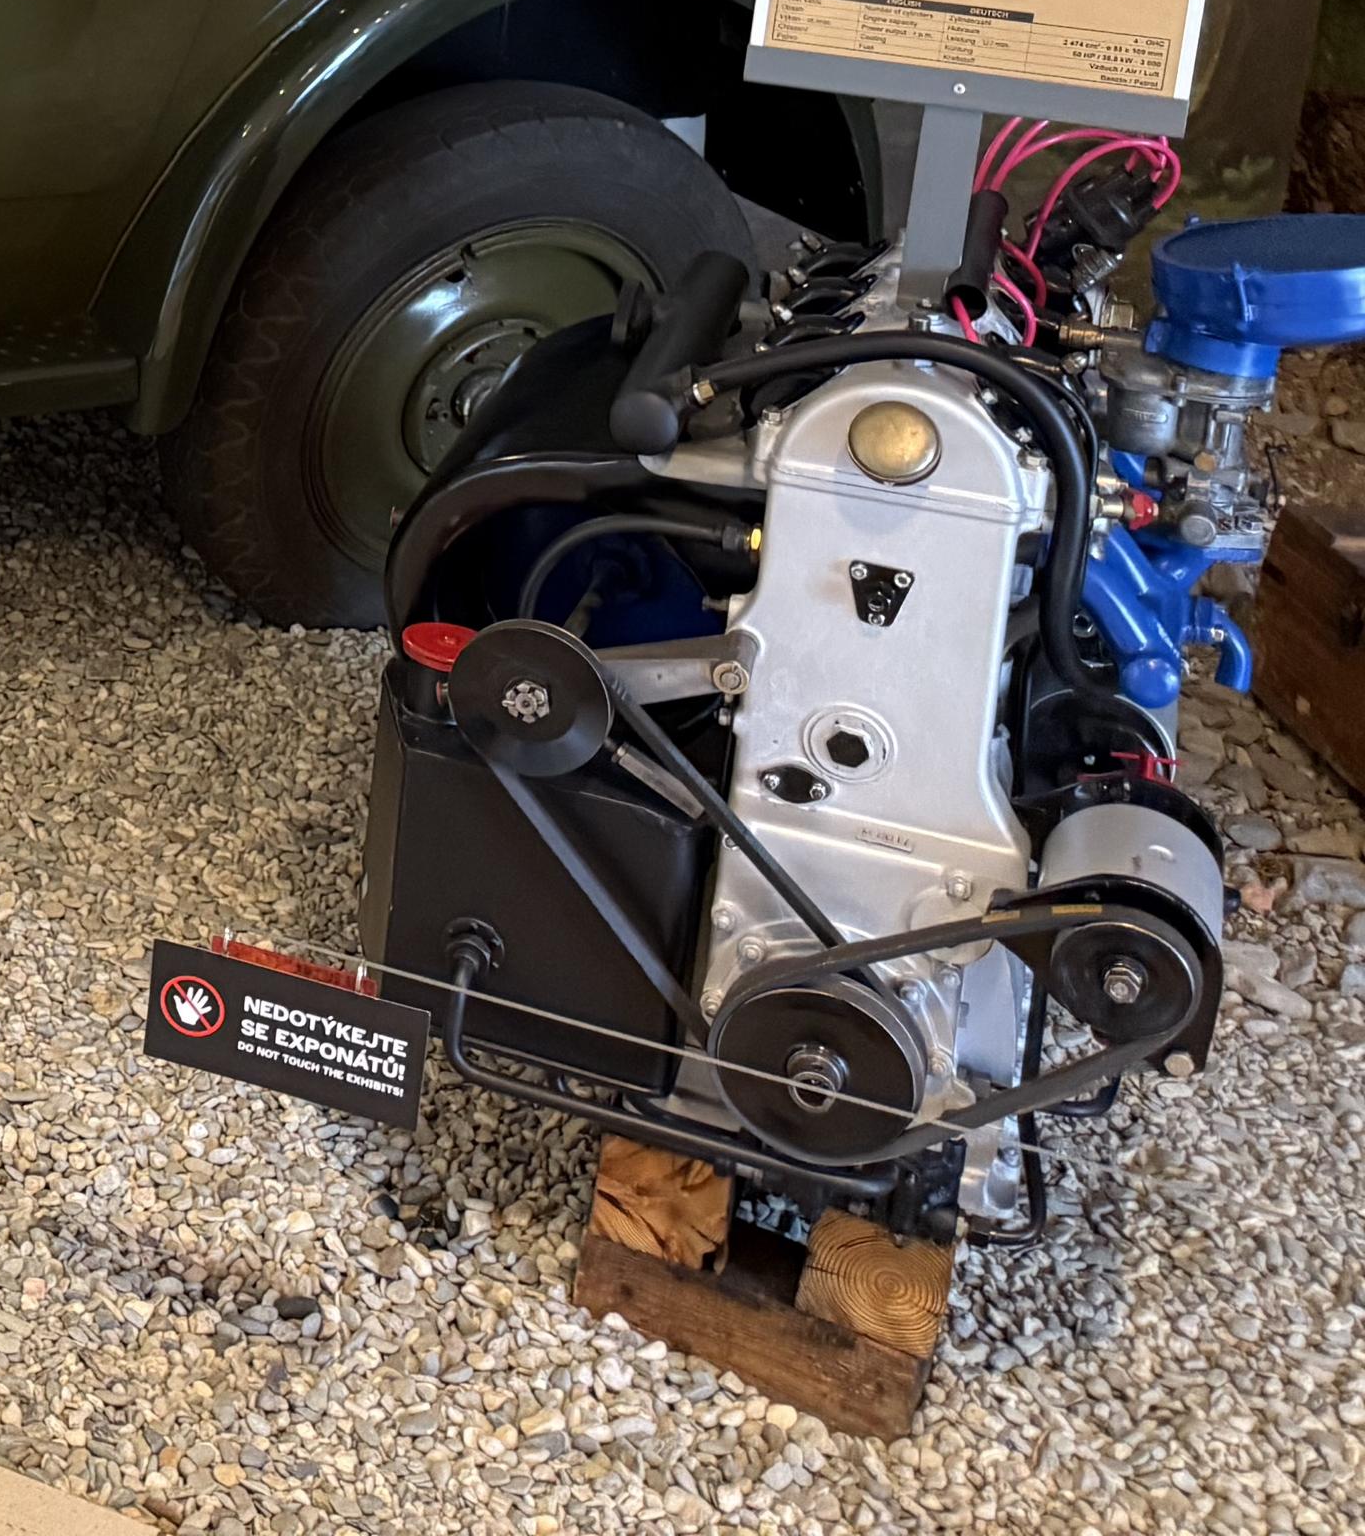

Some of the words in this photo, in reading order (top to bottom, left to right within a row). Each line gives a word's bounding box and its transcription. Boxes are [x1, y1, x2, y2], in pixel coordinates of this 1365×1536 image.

[969, 8, 1009, 18] DEUTSCH
[241, 1019, 269, 1042] SE
[275, 1028, 406, 1081] EXPONÁTŮ!
[243, 995, 408, 1057] NEDOTÝKEJTE
[237, 1041, 254, 1053] DO
[256, 1046, 281, 1060] NOT
[282, 1054, 320, 1074] TOUCH
[323, 1065, 345, 1081] THE
[346, 1072, 404, 1098] EXHIBITS!
